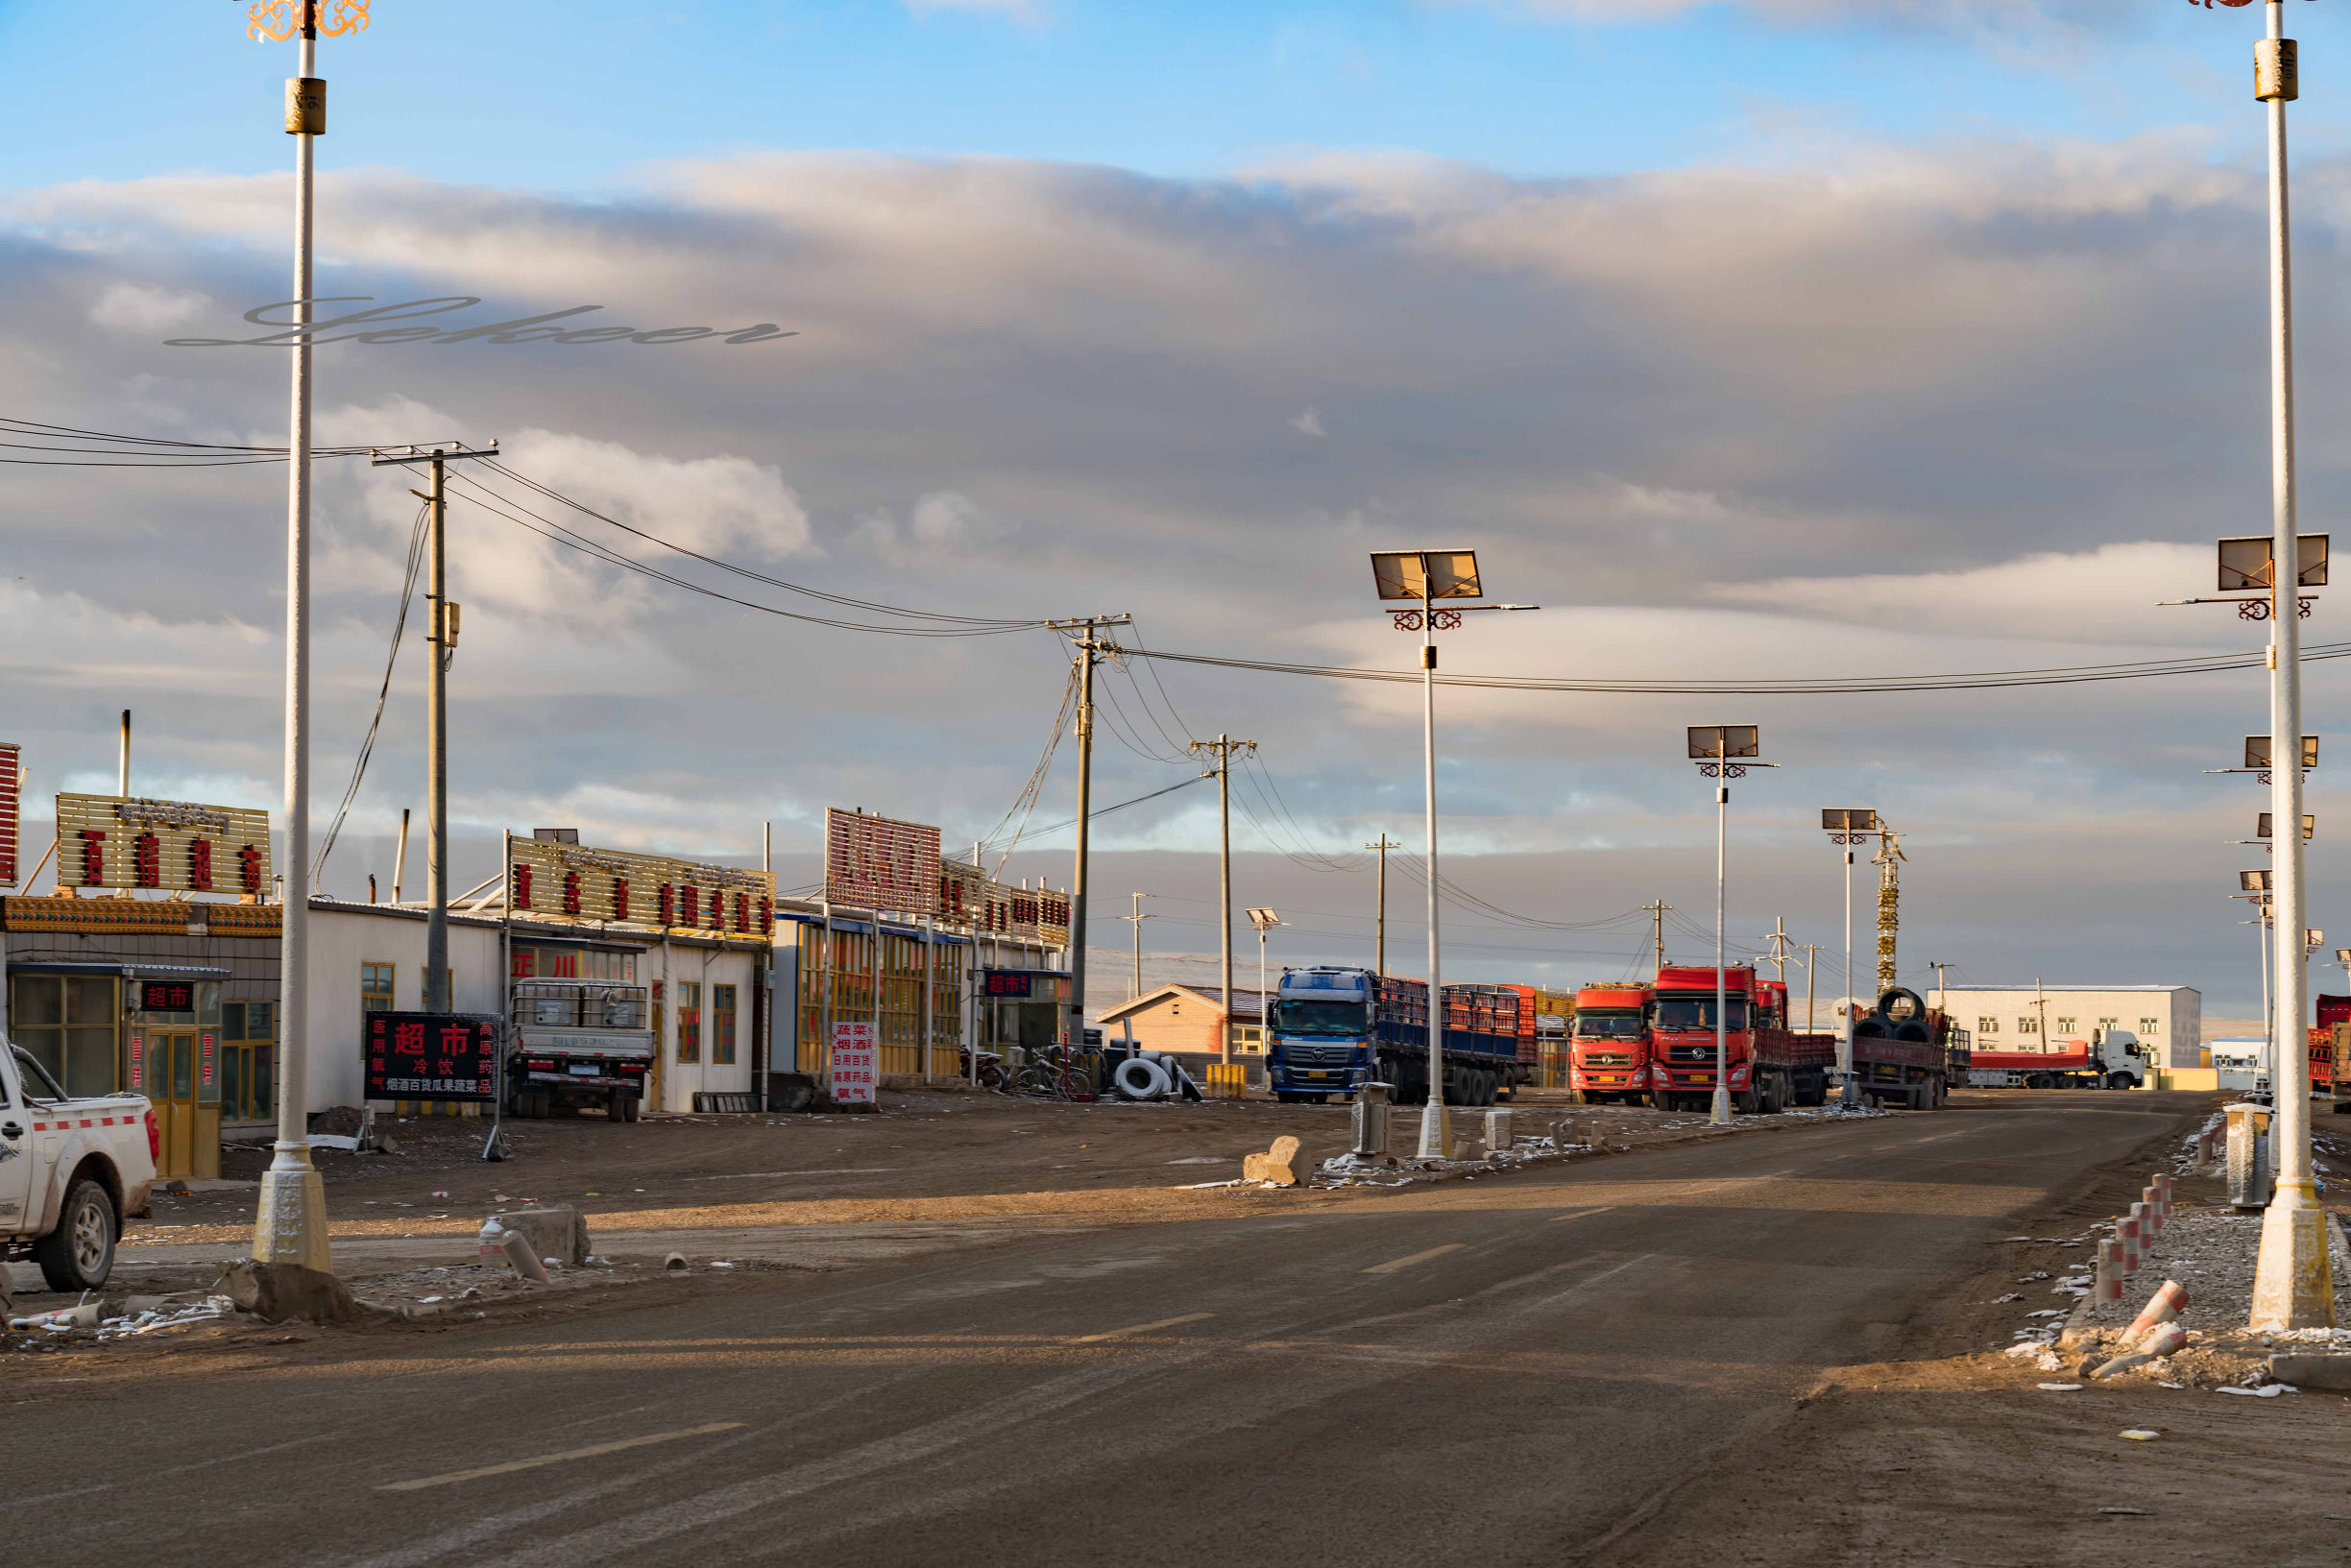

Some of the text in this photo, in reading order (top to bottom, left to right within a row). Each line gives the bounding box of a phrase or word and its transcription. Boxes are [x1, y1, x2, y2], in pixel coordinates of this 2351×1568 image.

[989, 975, 1019, 994] 超市
[146, 986, 189, 1006] 超市
[836, 1024, 867, 1036] 蔬菜
[394, 1022, 471, 1056] 超市
[836, 1039, 866, 1050] 烟酒
[371, 1020, 386, 1091] 医用氧气
[477, 1022, 493, 1094] 高原药品
[834, 1054, 870, 1066] 日用百货
[412, 1058, 453, 1075] 冷饮
[386, 1077, 477, 1093] 烟酒百货瓜果蔬菜
[834, 1072, 870, 1083] 高原药品
[836, 1088, 866, 1099] 氧气
